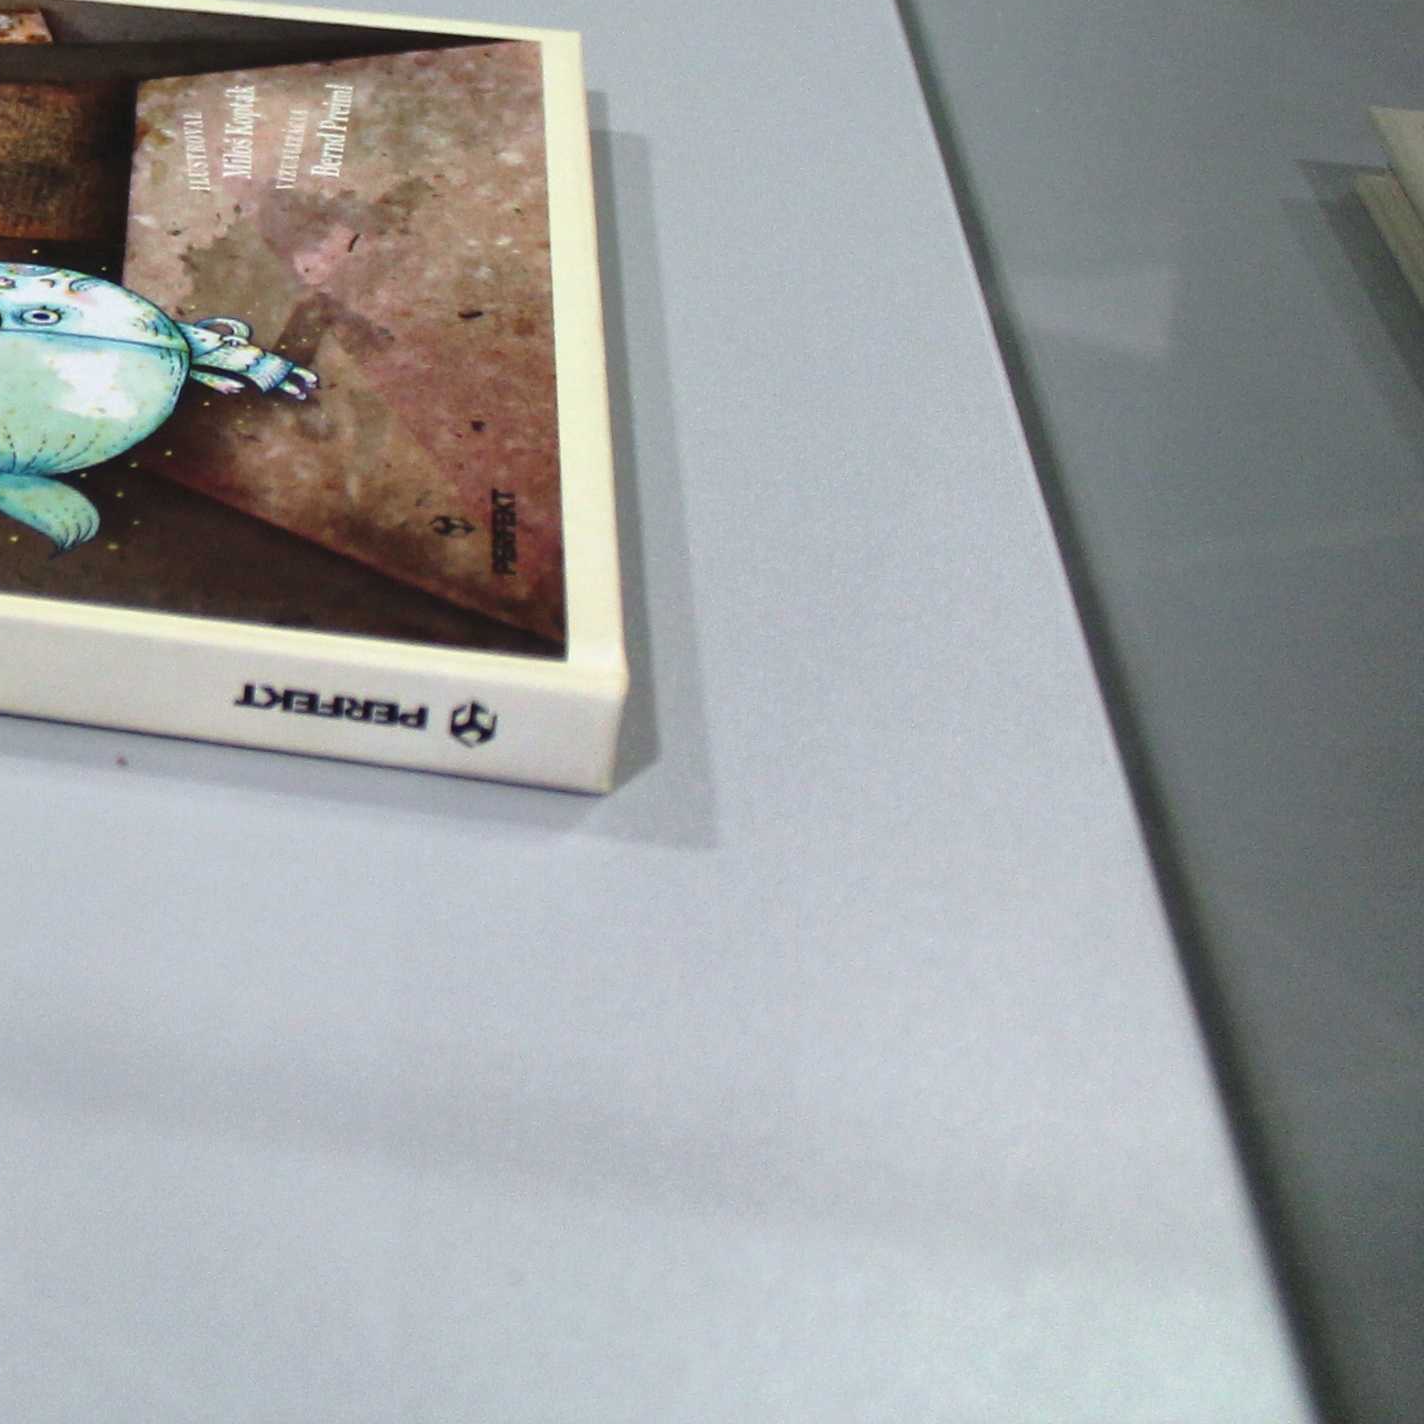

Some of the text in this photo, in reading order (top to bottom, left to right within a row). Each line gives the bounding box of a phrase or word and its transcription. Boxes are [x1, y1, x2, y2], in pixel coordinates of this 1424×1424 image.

[182, 113, 211, 191] ILUSTROVAL
[310, 131, 346, 176] Bernd
[491, 488, 517, 575] PERFEKT
[234, 683, 429, 729] PERFEKT
